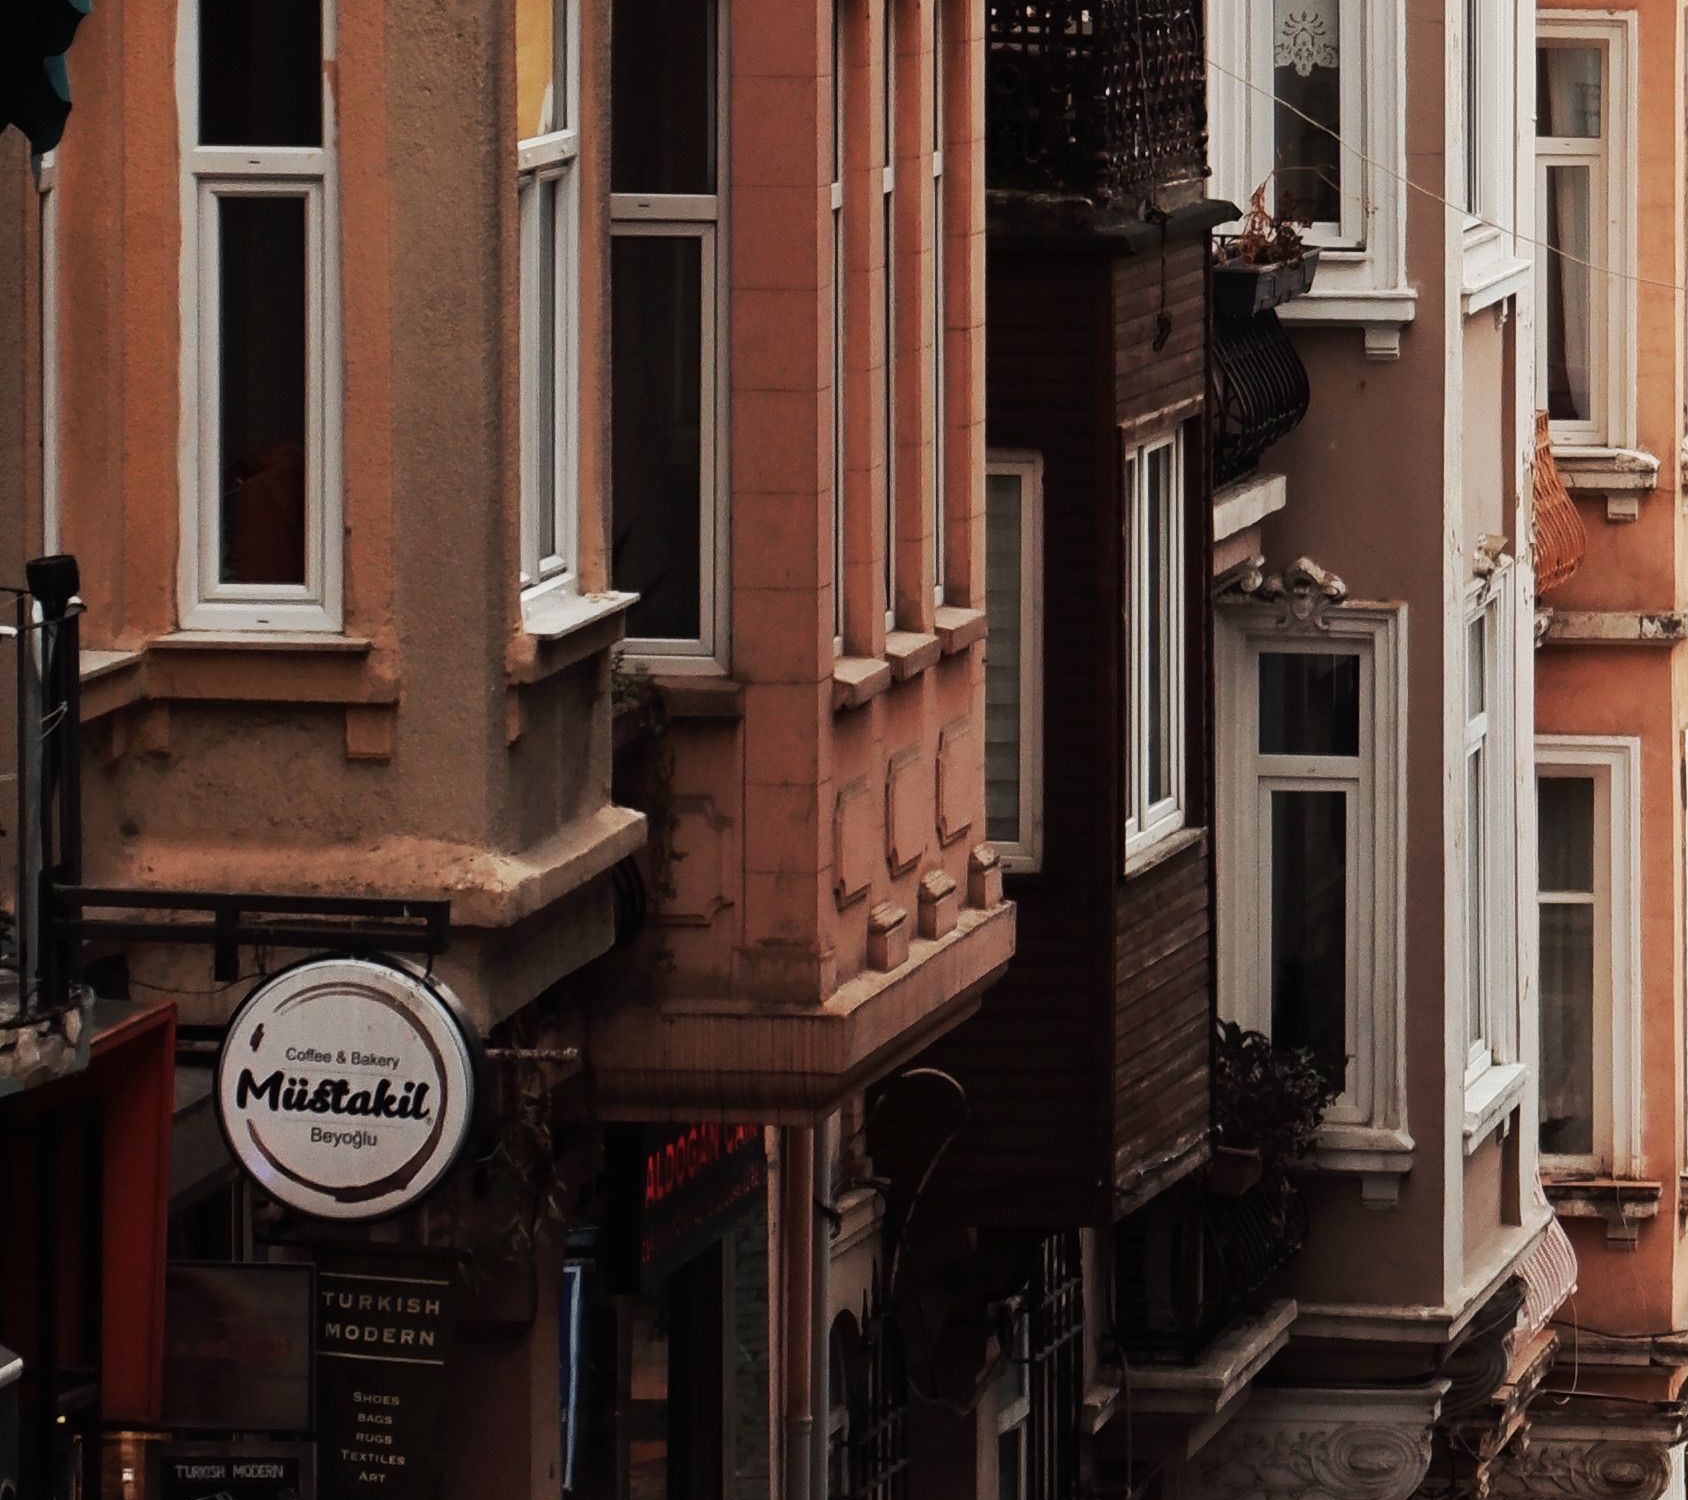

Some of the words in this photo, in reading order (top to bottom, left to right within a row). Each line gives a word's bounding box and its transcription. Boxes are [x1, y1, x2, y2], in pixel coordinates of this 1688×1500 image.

[286, 1047, 332, 1064] Coffee
[335, 1051, 346, 1065] &
[351, 1051, 400, 1070] Bakery
[310, 1127, 378, 1149] Beyoğlu
[322, 1290, 442, 1316] TURKISH
[323, 1322, 436, 1348] MODERN
